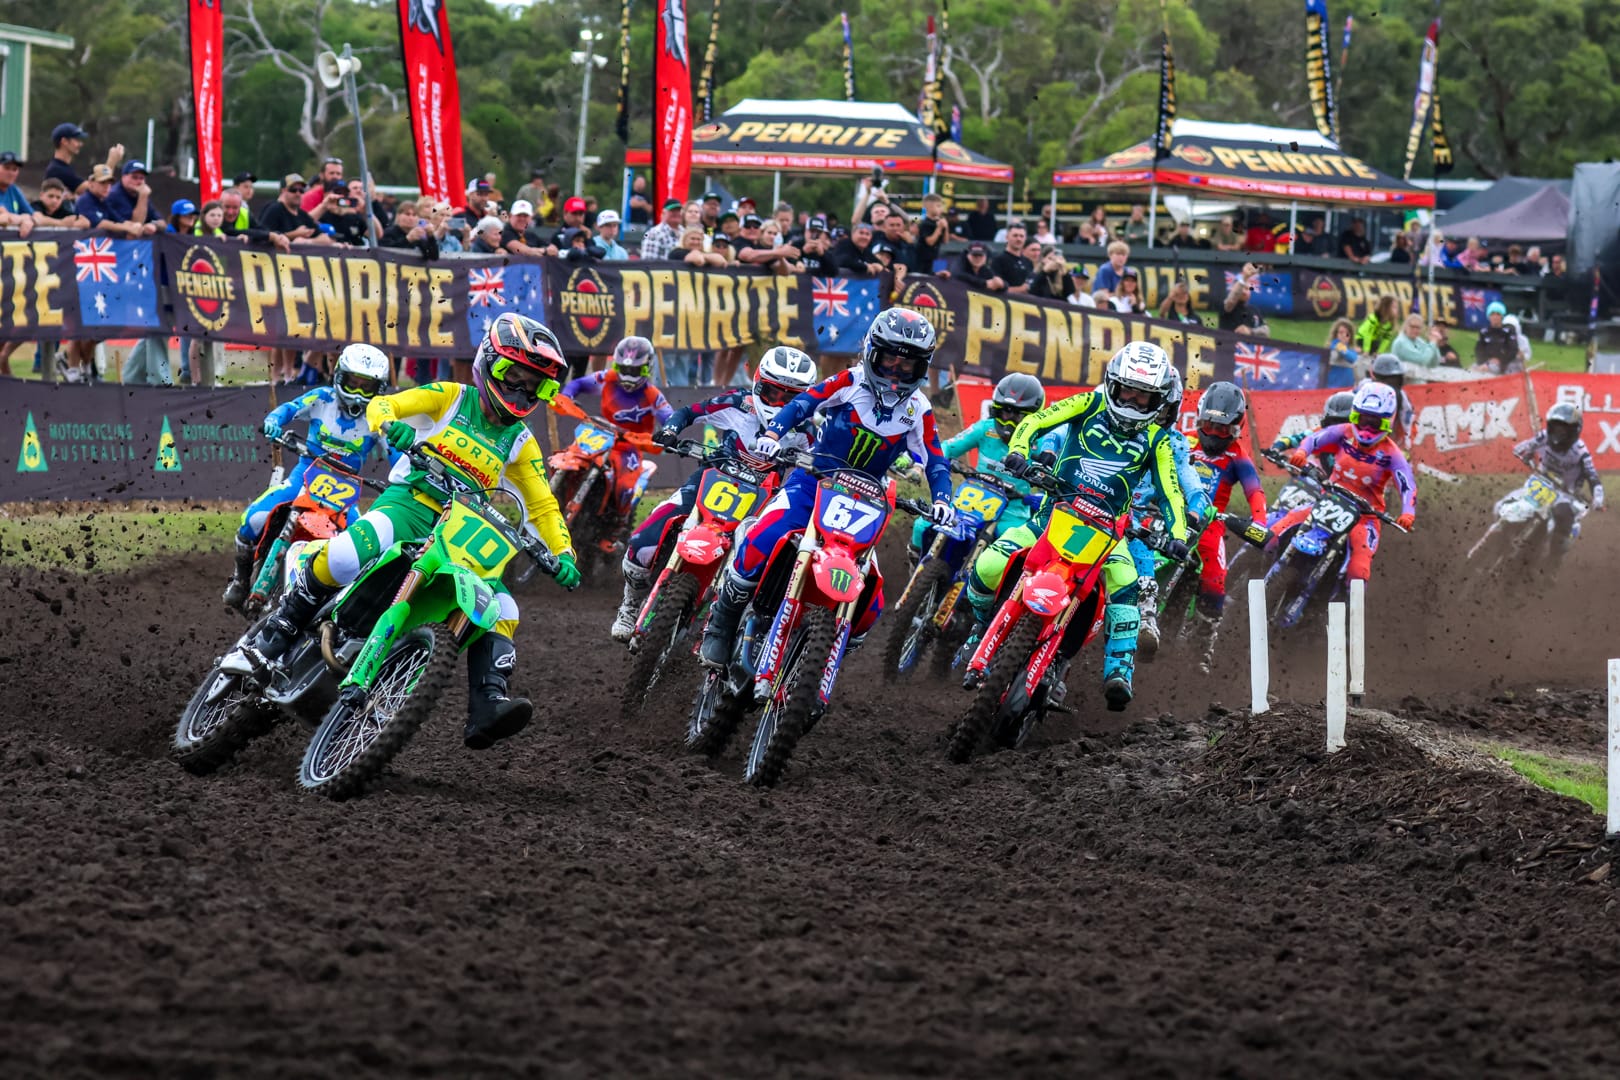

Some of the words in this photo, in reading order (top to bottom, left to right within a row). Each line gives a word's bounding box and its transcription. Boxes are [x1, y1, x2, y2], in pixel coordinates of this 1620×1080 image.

[728, 121, 908, 147] PENRITE
[1210, 146, 1377, 180] PENRITE
[0, 241, 64, 327] TE
[176, 270, 236, 300] PENRITE
[239, 250, 455, 347] PENRITE
[560, 291, 616, 317] PENRITE
[619, 269, 805, 350] PENRITE
[966, 290, 1217, 391] PENRITE
[49, 423, 133, 441] MOTORCYCLING
[899, 415, 915, 426] HGS
[51, 445, 136, 462] AUSTRALIA
[436, 443, 494, 489] Kawasaki
[442, 429, 502, 475] FORTH
[309, 473, 356, 508] 62
[838, 472, 882, 494] RENTHAL
[1073, 469, 1116, 496] HONDA
[703, 480, 757, 521] 61
[821, 494, 881, 535] 67
[953, 486, 1003, 522] 84
[1311, 499, 1355, 533] 329
[449, 515, 510, 571] 10
[1062, 524, 1097, 556] 1
